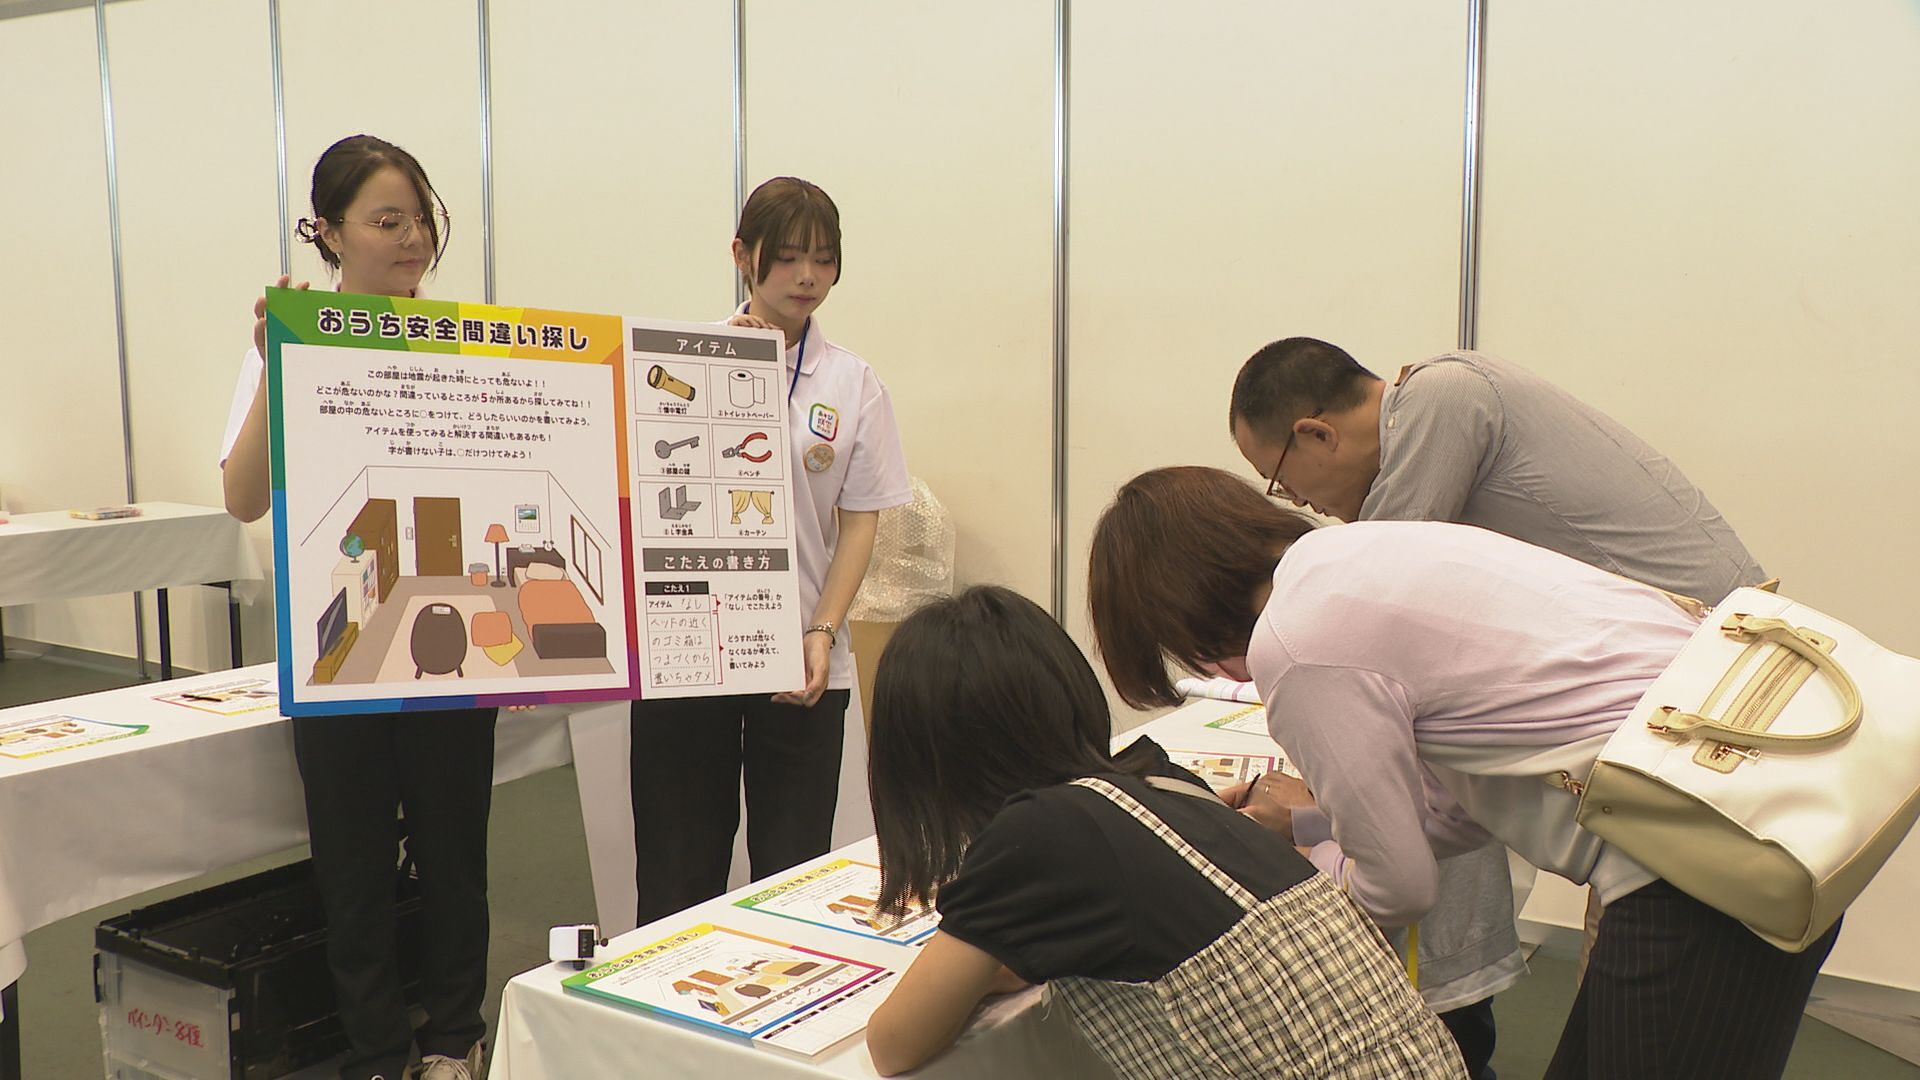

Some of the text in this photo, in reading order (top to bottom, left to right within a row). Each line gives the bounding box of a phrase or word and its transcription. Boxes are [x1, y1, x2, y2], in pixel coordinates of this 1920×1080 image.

[317, 307, 589, 351] おうち安全間違い探し
[676, 338, 737, 356] アイテム
[664, 554, 771, 570] こたえの書き方
[664, 584, 690, 593] こたえ1
[681, 598, 702, 610] なし
